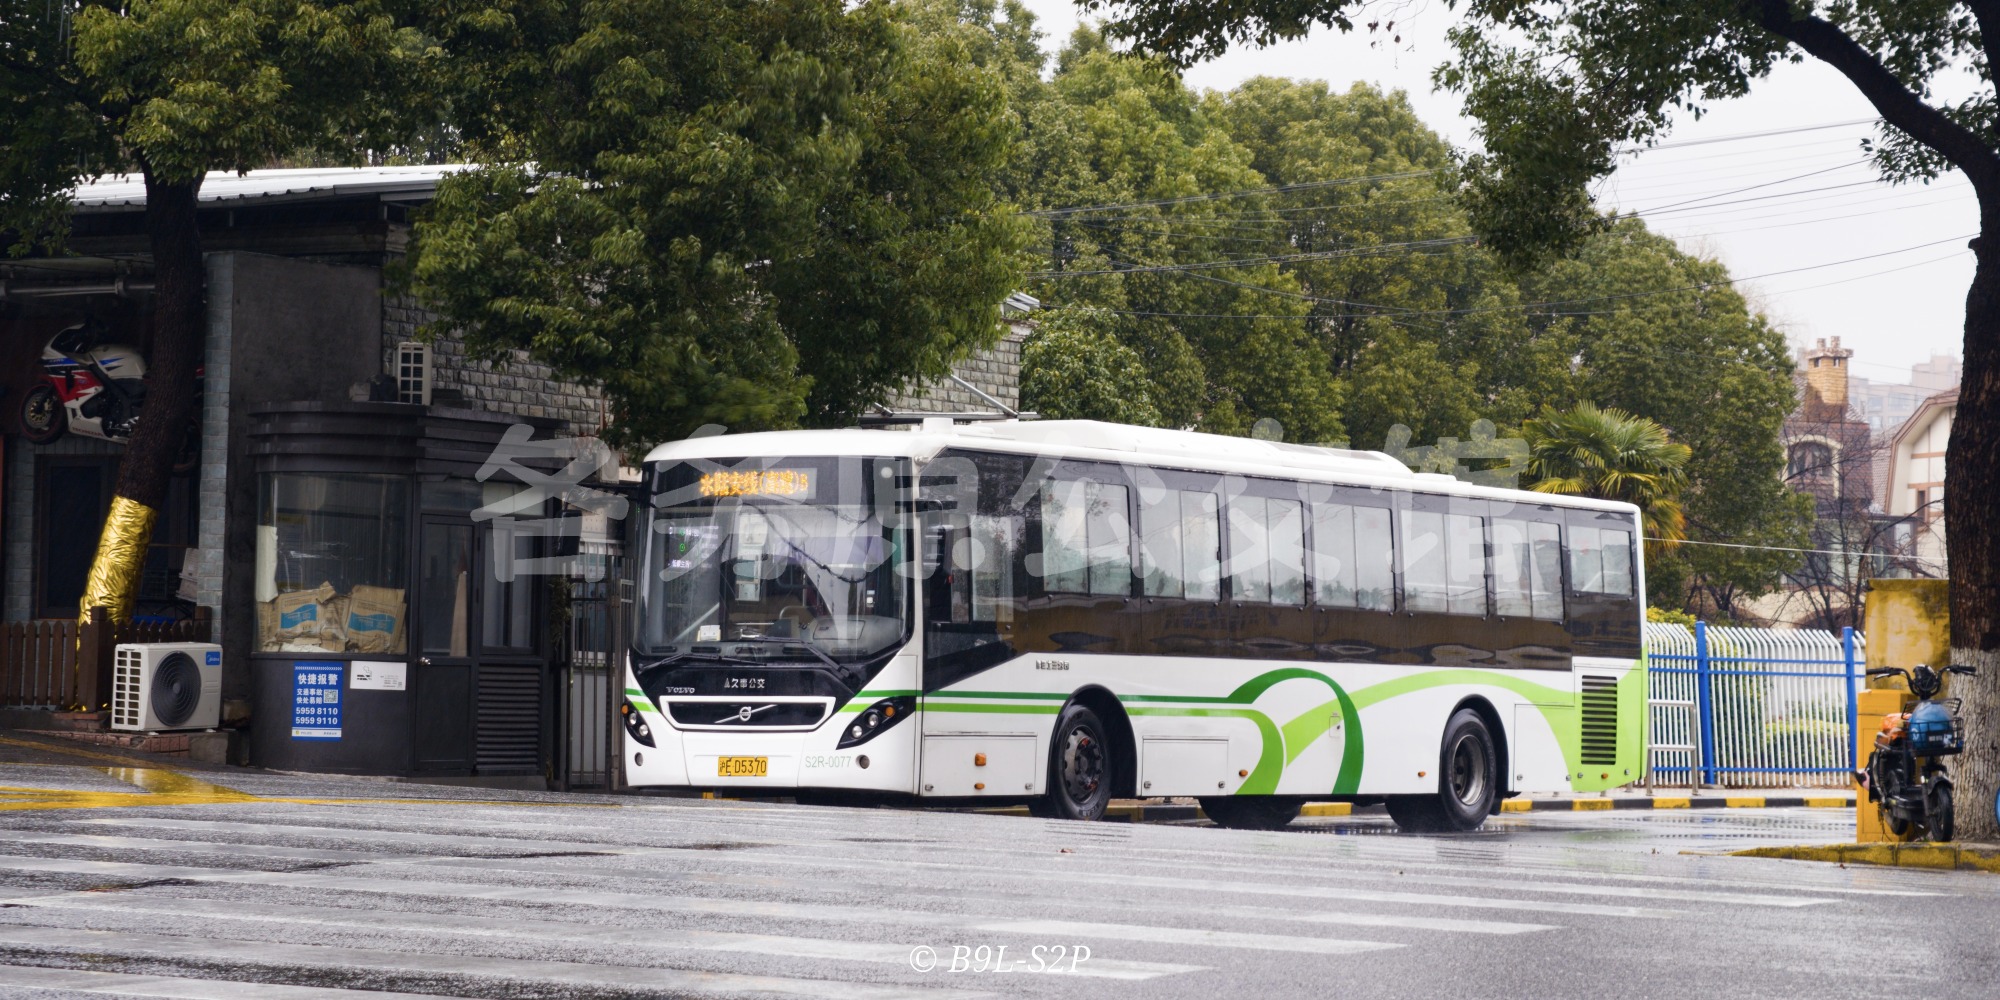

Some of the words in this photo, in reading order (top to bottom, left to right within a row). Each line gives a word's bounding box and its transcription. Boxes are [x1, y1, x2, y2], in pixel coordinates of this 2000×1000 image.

[298, 673, 338, 685] 快捷报警
[666, 686, 695, 694] VOLVO
[317, 707, 338, 715] 8110
[804, 755, 852, 768] S2R-0077
